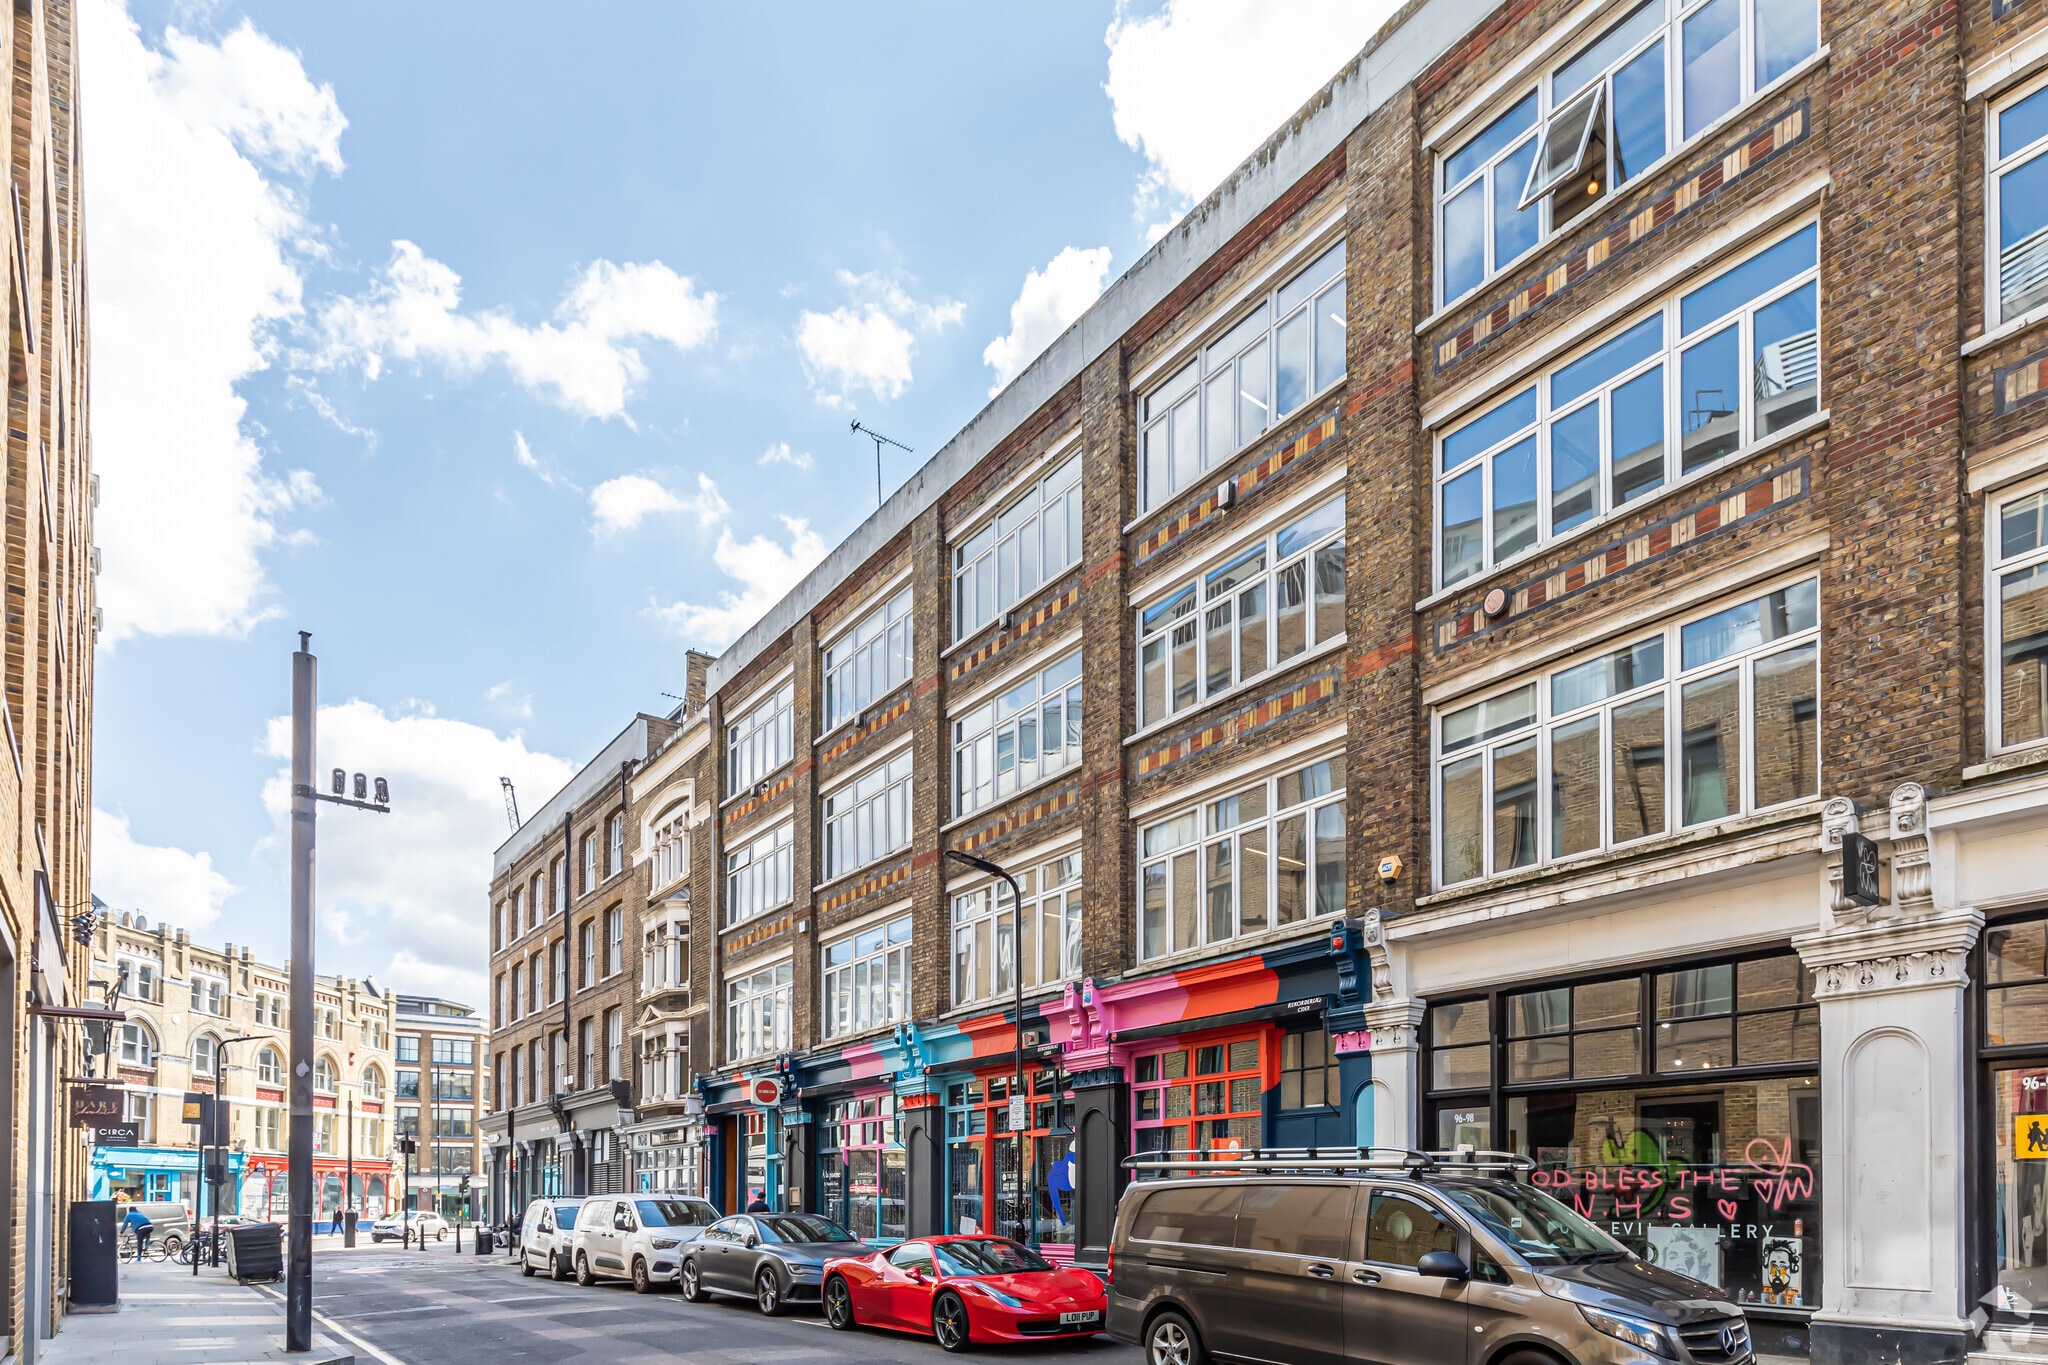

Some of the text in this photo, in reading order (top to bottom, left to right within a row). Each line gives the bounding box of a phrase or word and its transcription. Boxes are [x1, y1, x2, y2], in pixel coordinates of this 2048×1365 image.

[2022, 1076, 2048, 1090] 96-
[1454, 1113, 1475, 1124] 96-98
[99, 1128, 134, 1136] CIRCA
[1585, 1168, 1663, 1190] BLESS
[1675, 1169, 1742, 1190] THE
[1081, 1312, 1095, 1320] PUP
